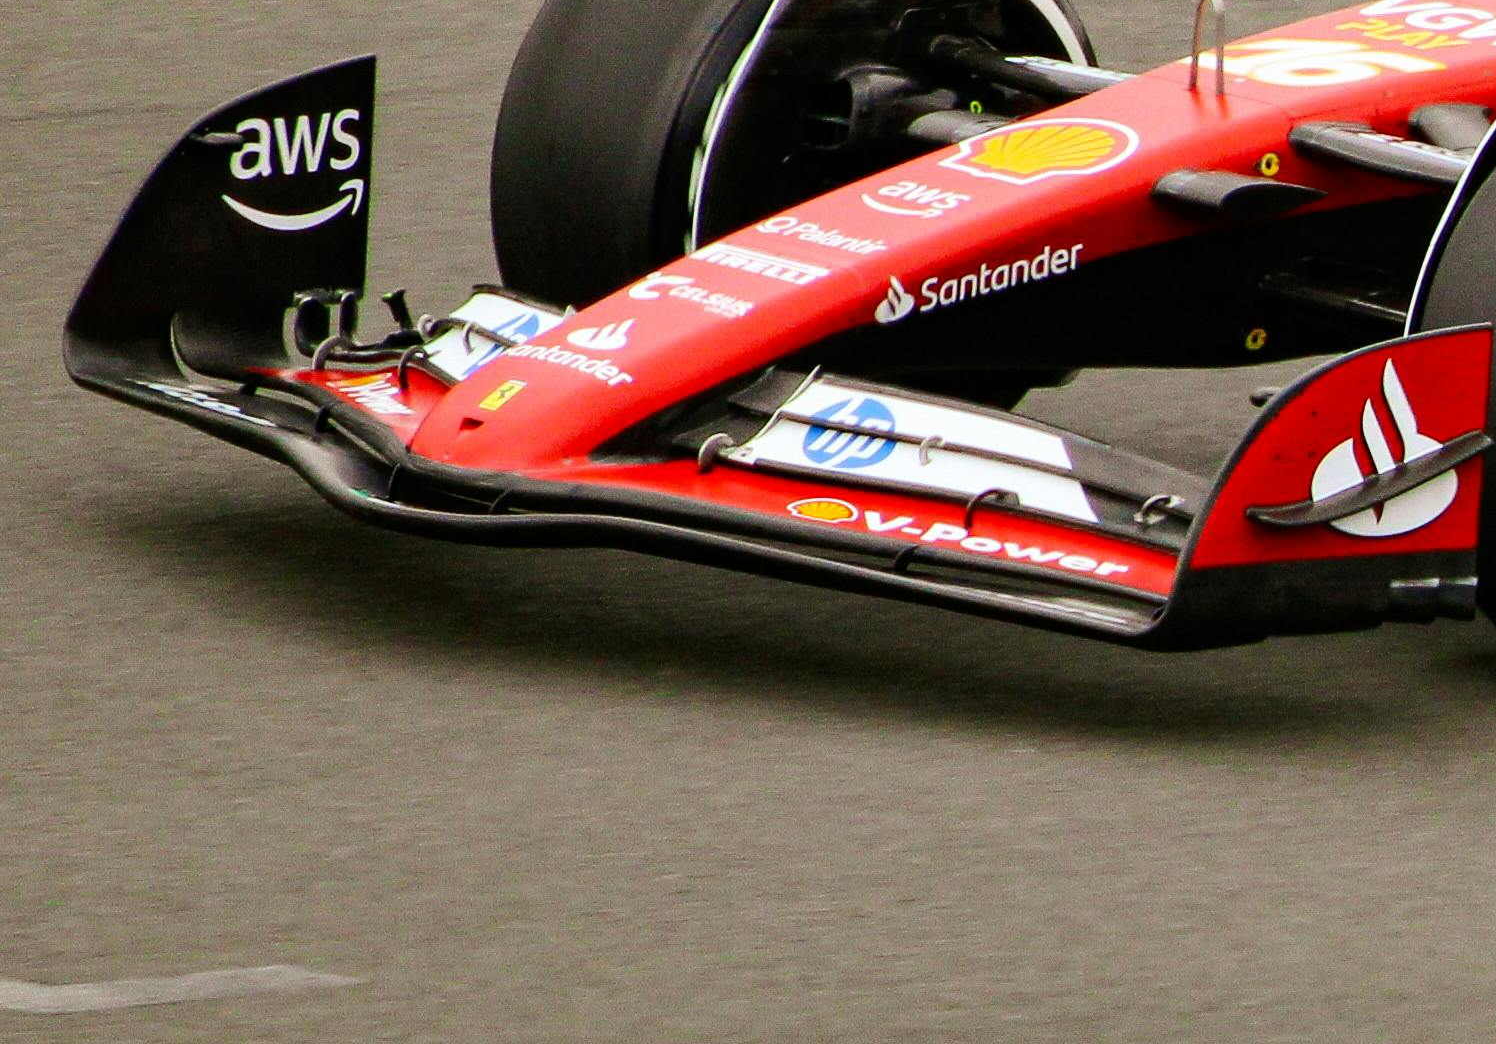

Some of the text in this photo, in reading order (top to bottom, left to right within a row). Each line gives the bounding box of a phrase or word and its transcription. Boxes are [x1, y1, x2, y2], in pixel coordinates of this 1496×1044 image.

[1335, 18, 1470, 50] PLAY
[230, 108, 361, 180] aws
[878, 180, 971, 211] aws
[787, 221, 889, 256] Palantir
[690, 243, 831, 285] PIRELLI
[920, 244, 1084, 313] Santander
[505, 344, 633, 387] antander
[806, 397, 895, 468] hp
[864, 510, 1129, 576] V-Power
